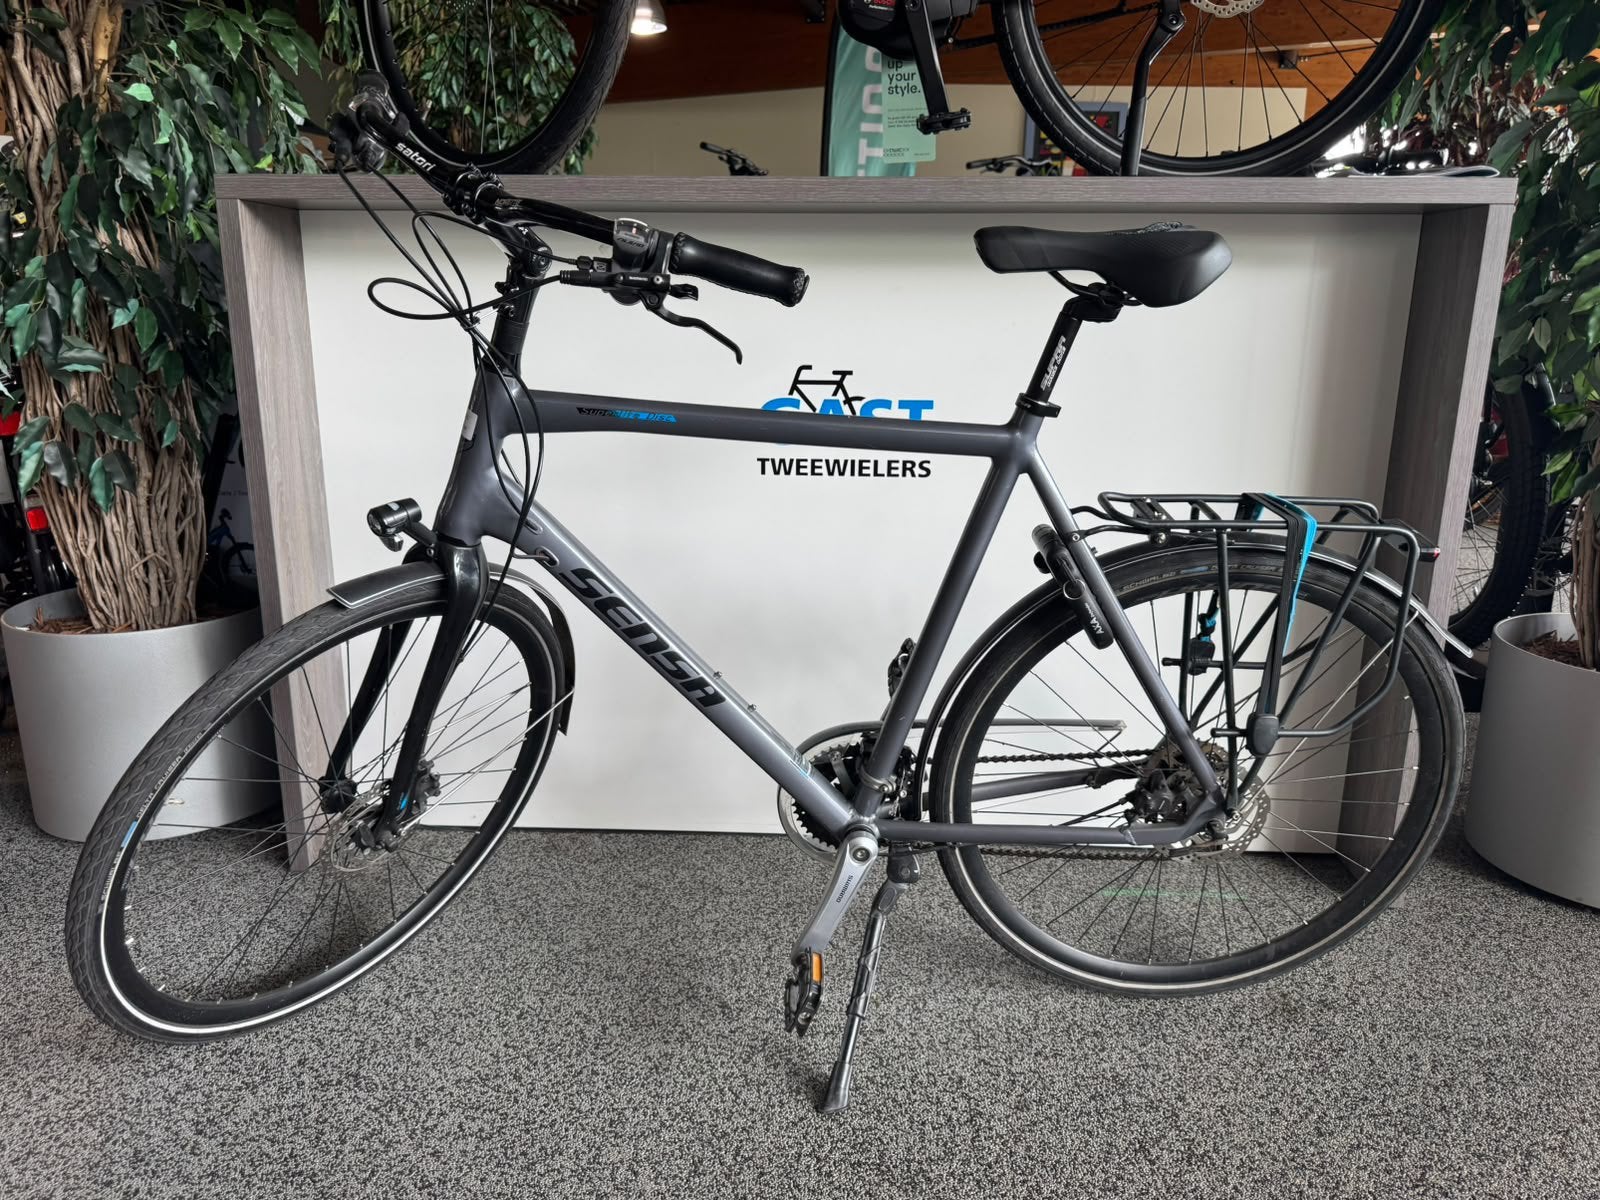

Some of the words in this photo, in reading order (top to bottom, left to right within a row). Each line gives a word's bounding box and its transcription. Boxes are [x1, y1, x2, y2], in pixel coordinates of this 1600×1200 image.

[888, 60, 903, 71] up
[888, 72, 916, 85] your
[888, 82, 921, 97] style.
[395, 142, 436, 172] satori
[757, 457, 932, 478] TWEEWIELERS
[1090, 614, 1105, 635] AXA
